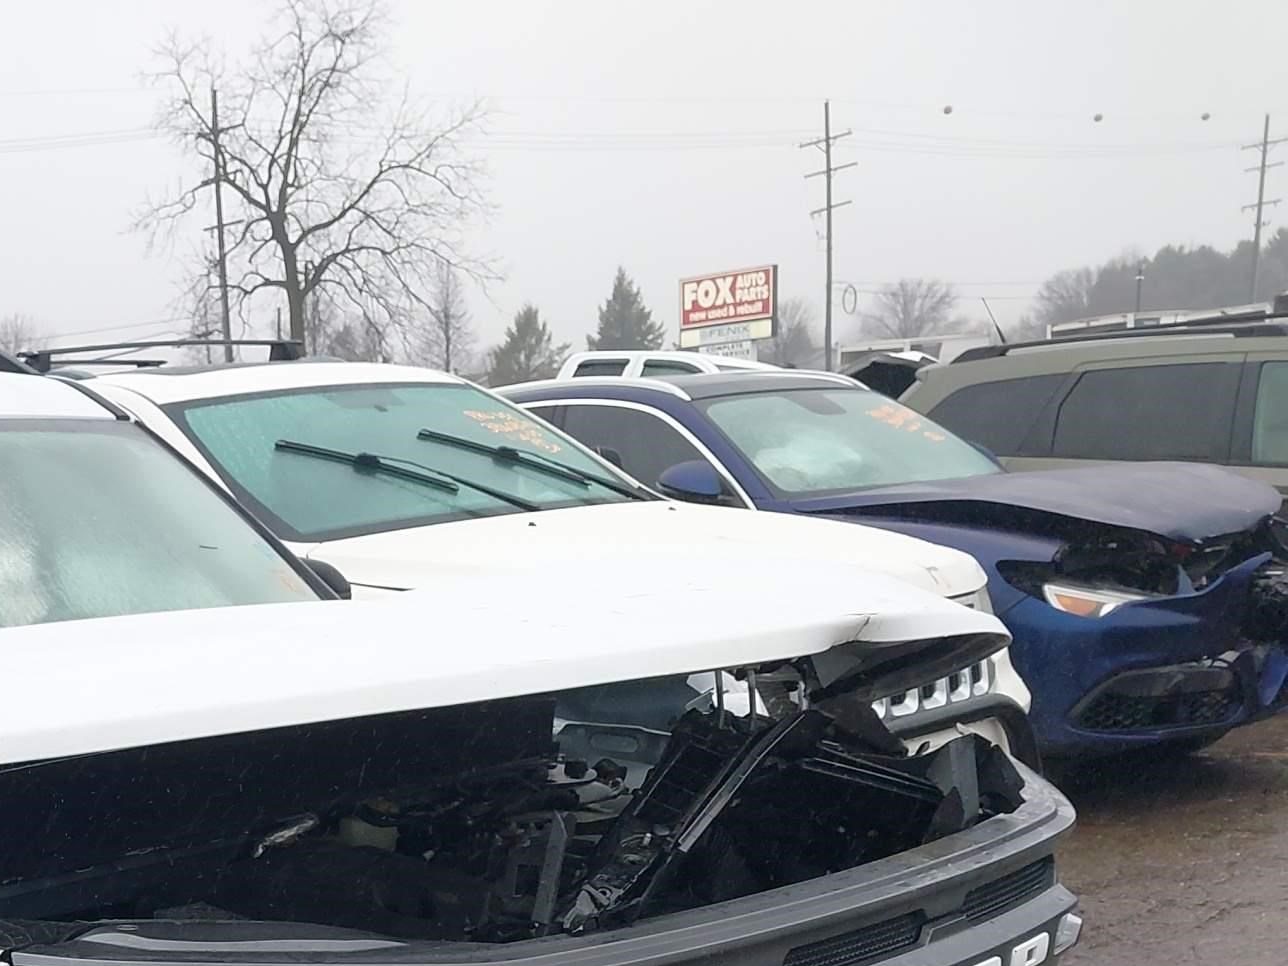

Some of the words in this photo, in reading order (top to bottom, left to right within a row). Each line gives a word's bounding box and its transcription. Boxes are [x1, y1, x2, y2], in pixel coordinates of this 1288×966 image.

[736, 271, 765, 289] AUTO
[684, 276, 734, 311] FOX
[735, 285, 769, 303] PARTS
[707, 305, 728, 319] used
